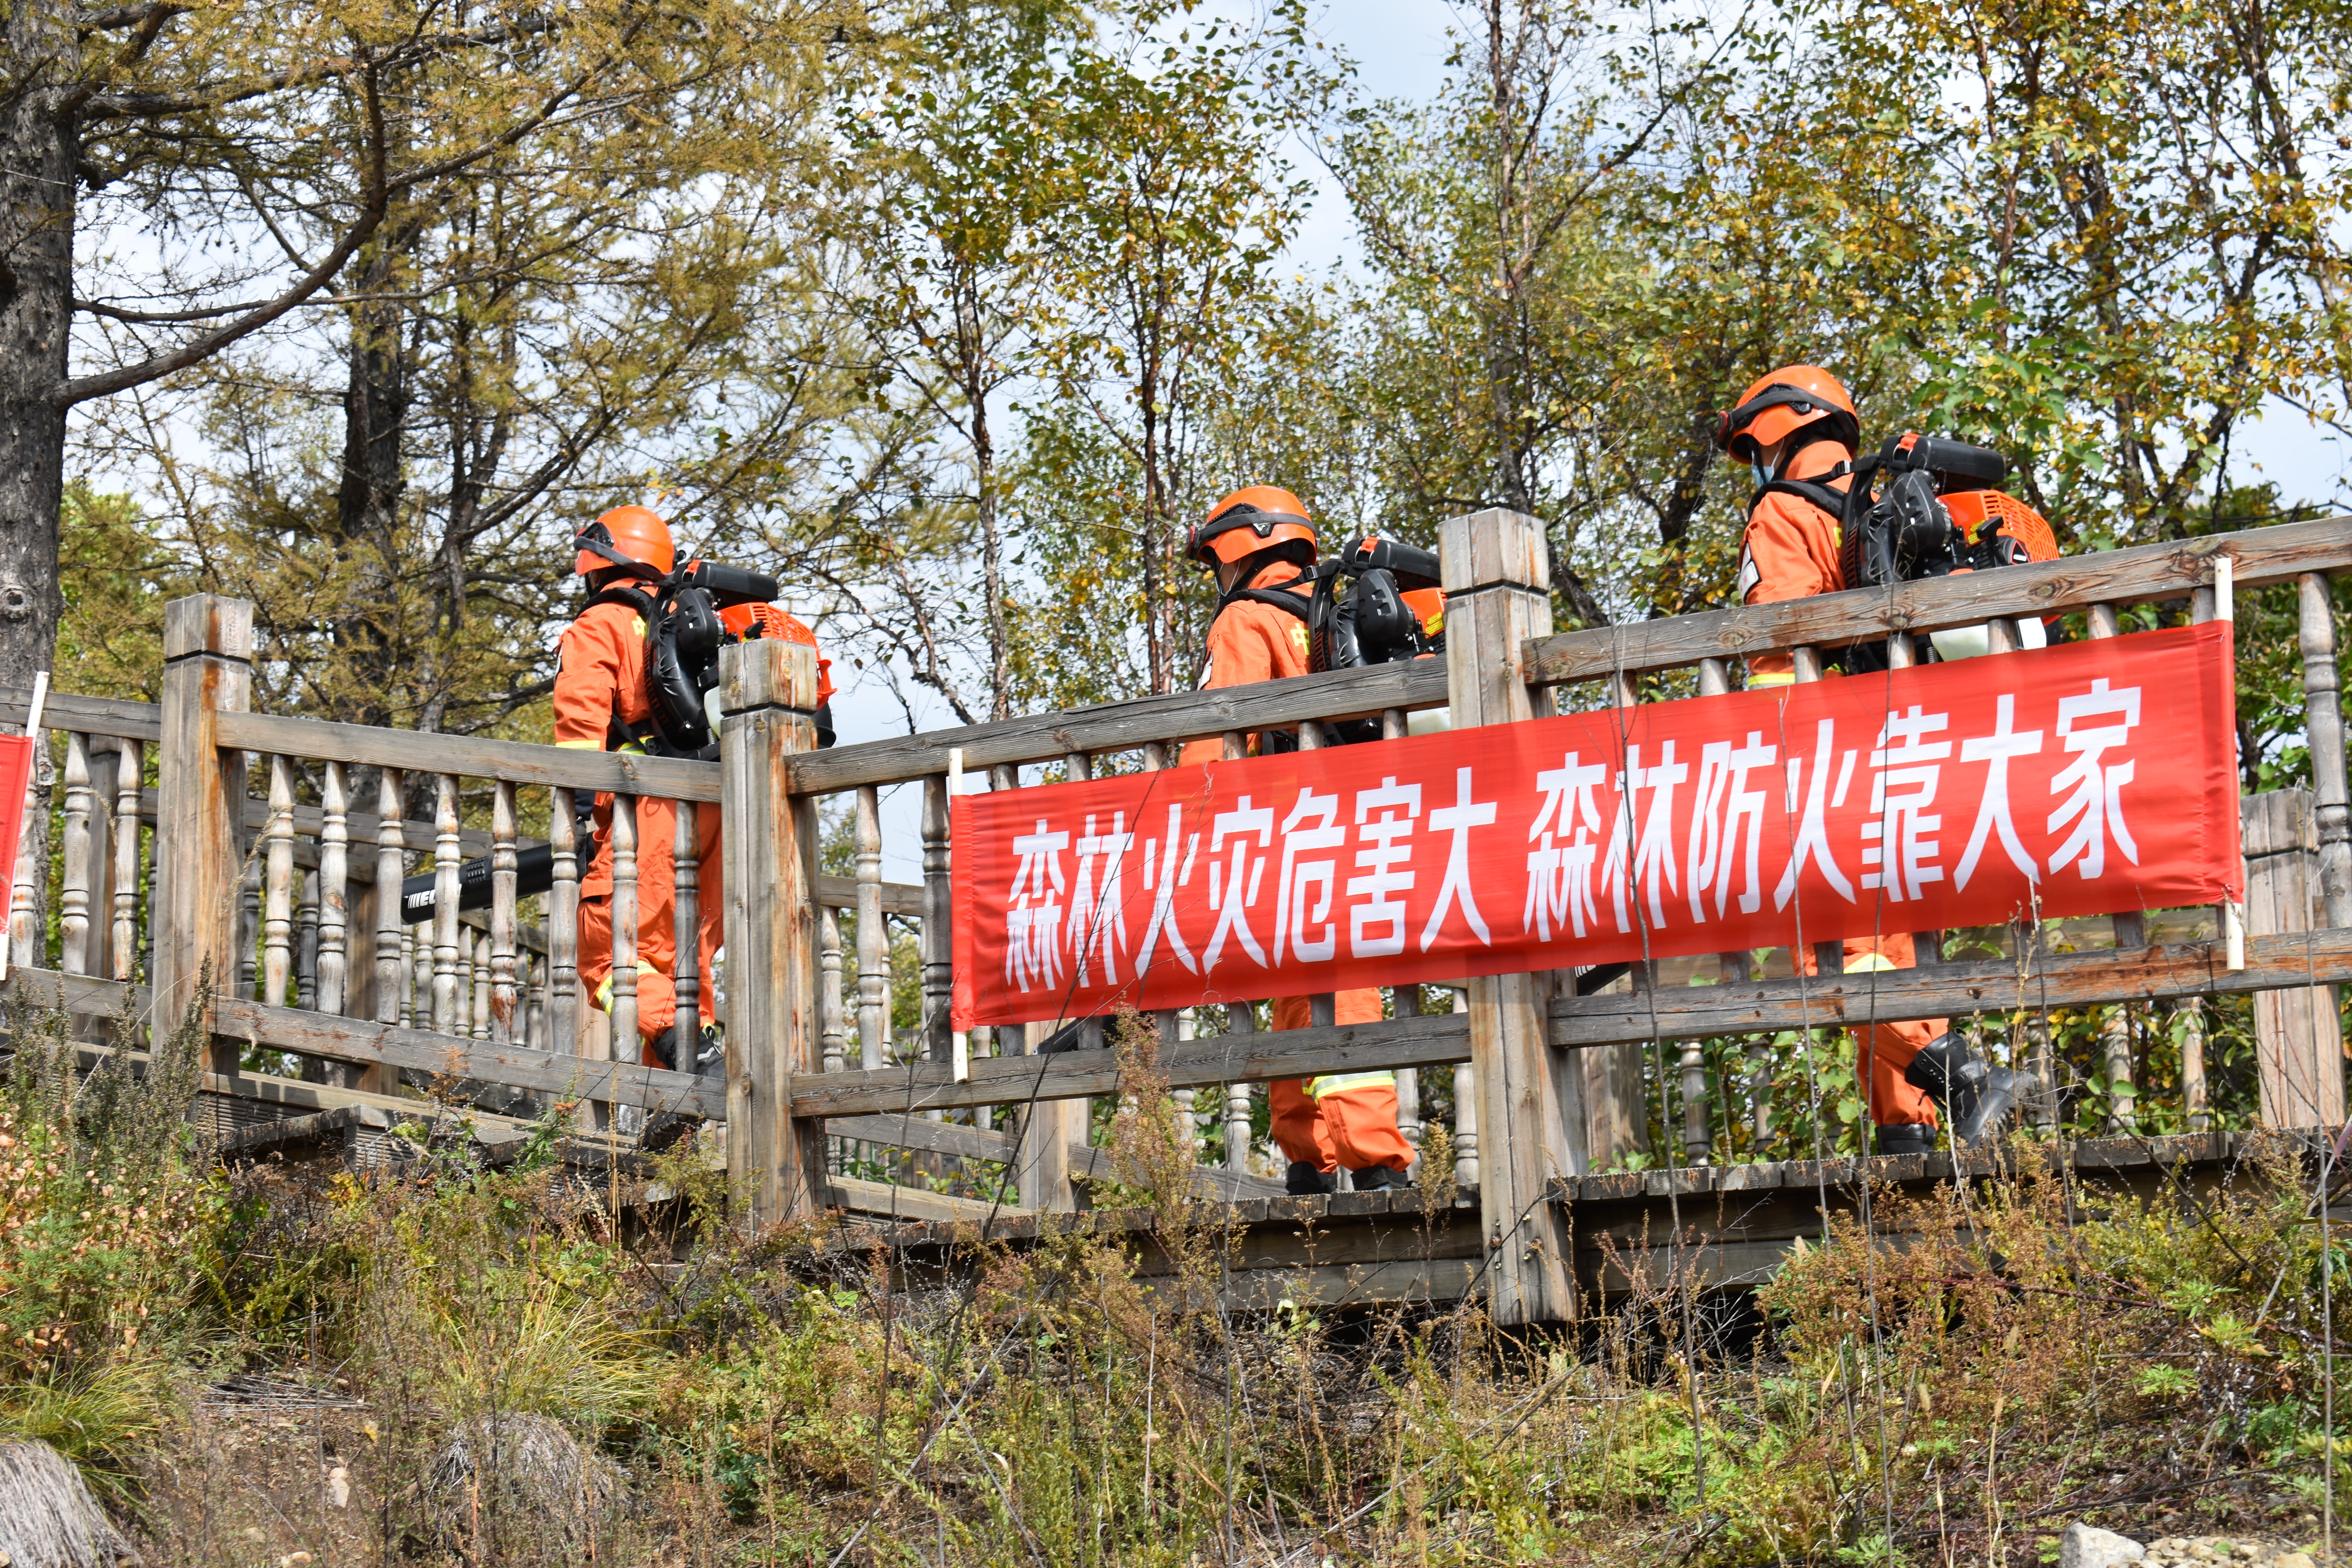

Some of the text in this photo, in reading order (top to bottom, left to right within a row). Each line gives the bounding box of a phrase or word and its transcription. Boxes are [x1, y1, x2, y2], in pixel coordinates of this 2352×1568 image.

[1006, 678, 2141, 993] 森林火灾危害大 森林防火靠大家
